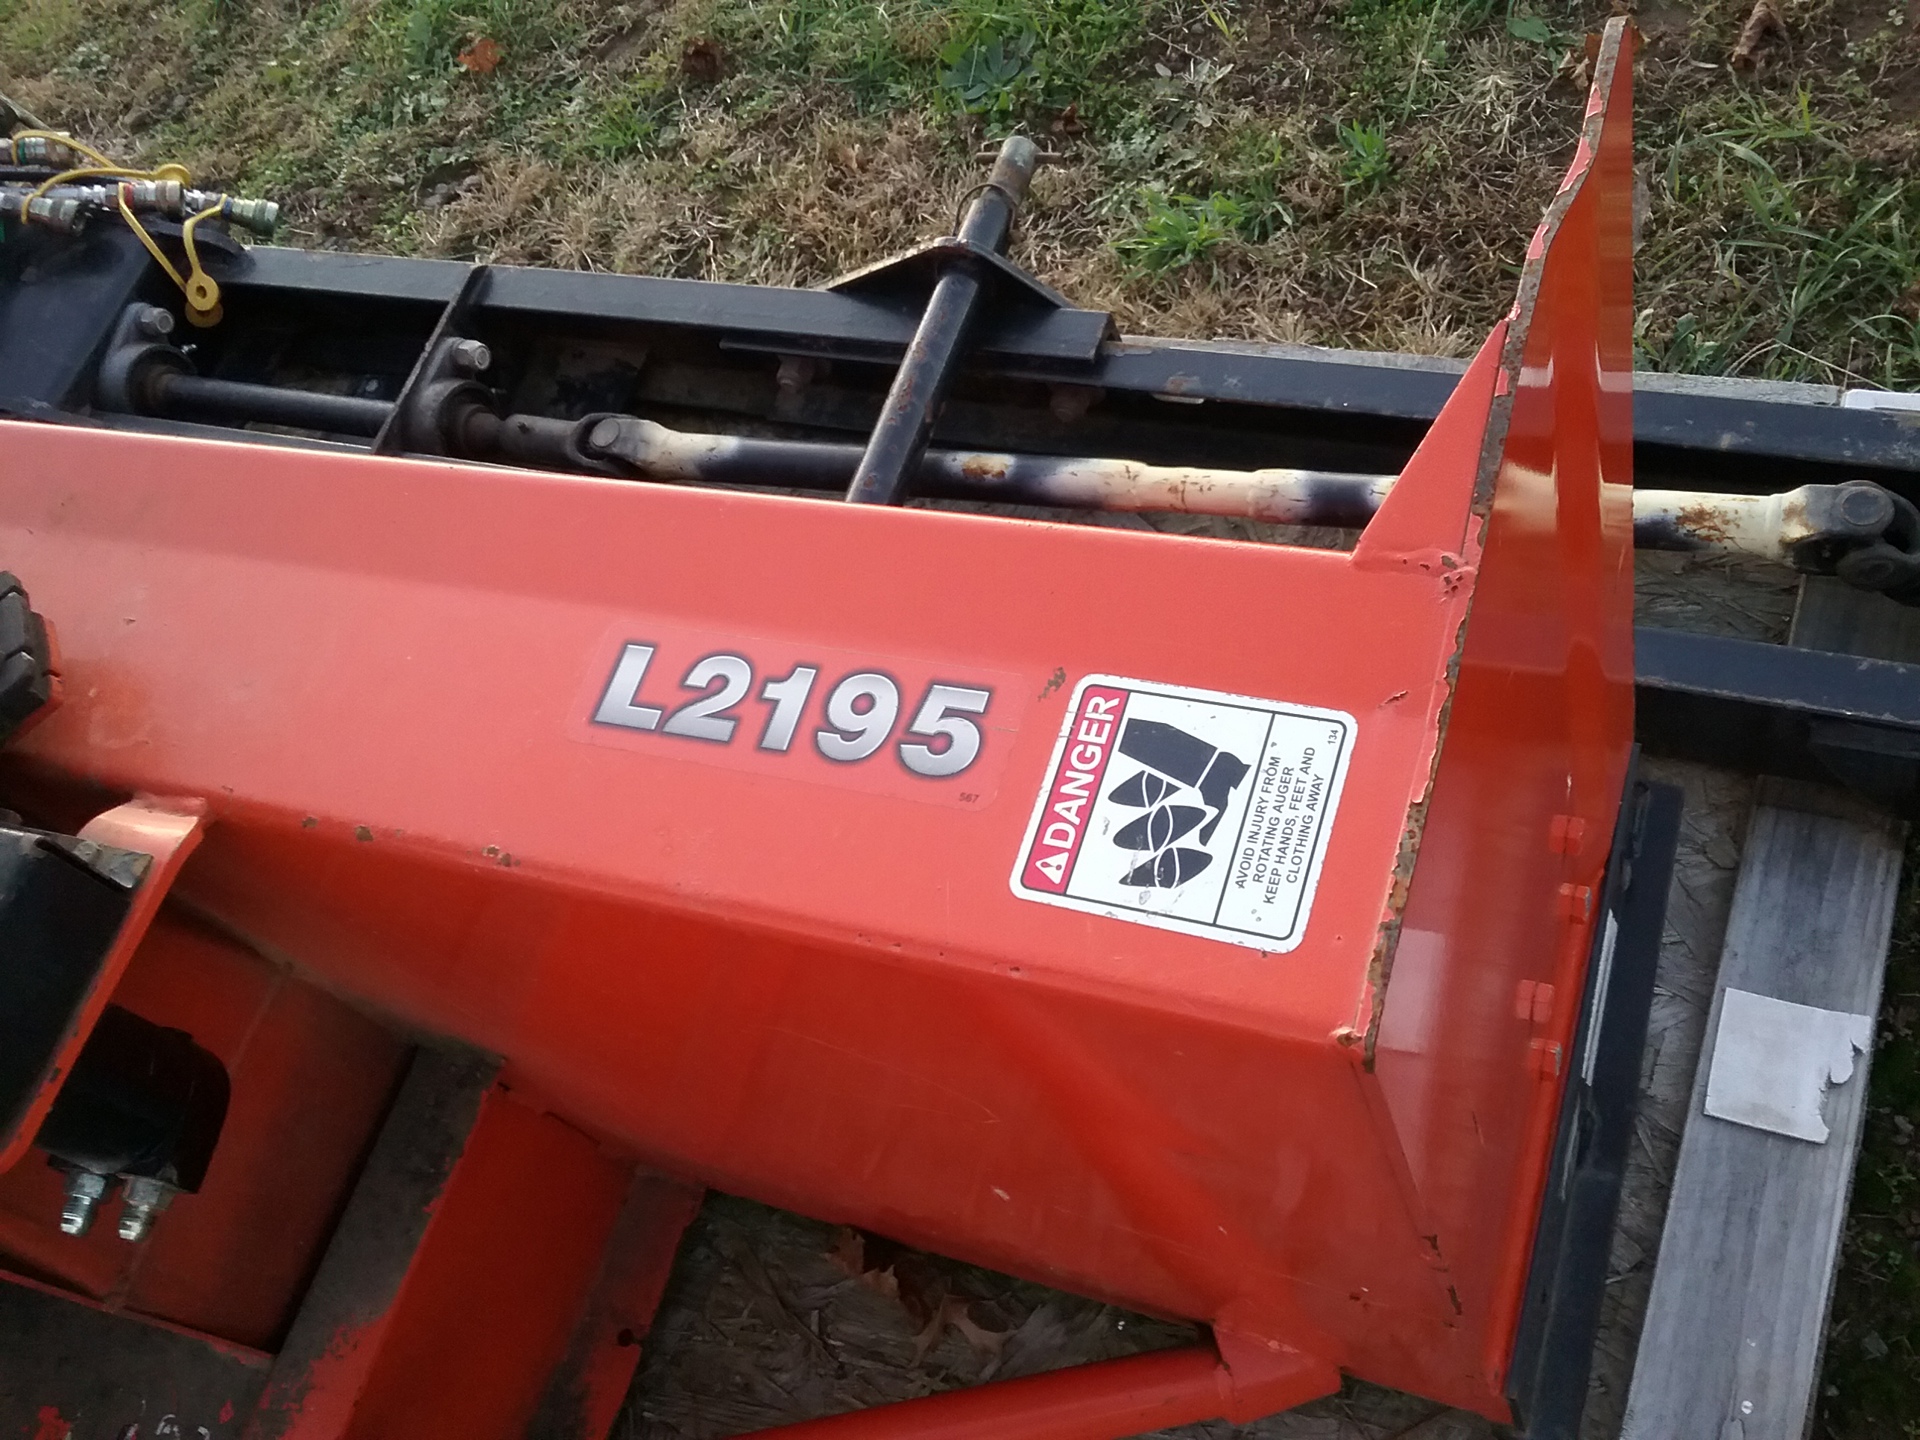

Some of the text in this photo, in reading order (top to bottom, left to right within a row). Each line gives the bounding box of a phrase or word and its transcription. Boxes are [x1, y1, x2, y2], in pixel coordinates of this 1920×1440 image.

[593, 643, 991, 777] L2195
[1042, 696, 1120, 850] DANGER
[1327, 729, 1339, 745] 134
[1235, 756, 1281, 889] AVOID INJURY FROM
[1252, 766, 1294, 884] ROTATING AUGER
[1263, 747, 1316, 905] KEEP HANDS, FEET AND
[1286, 774, 1324, 884] CLOTHING AWAY
